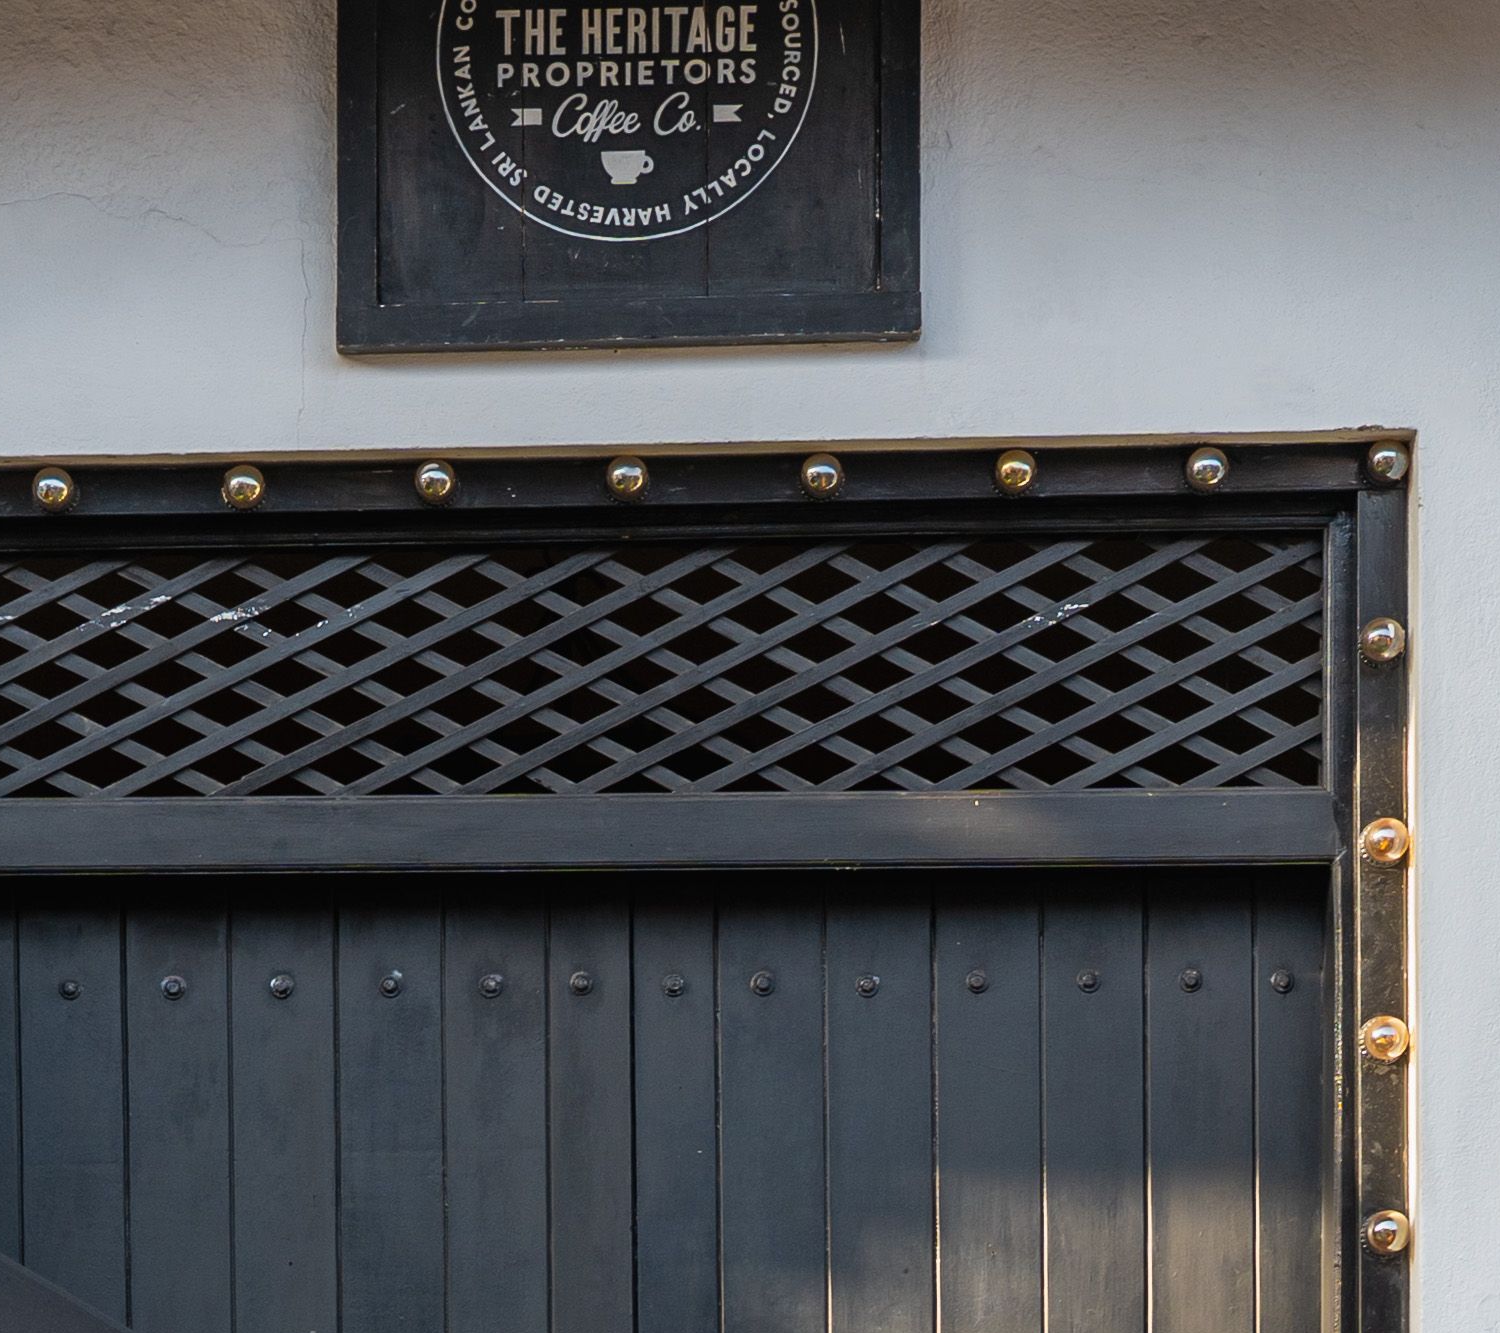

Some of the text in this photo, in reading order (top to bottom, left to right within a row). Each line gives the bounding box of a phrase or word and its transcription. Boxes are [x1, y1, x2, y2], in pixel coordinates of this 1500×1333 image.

[496, 5, 758, 55] THE HERITAGE
[497, 58, 757, 87] PROPRIETORS
[453, 45, 496, 151] LANKAN
[551, 92, 702, 142] Coffee Co.
[491, 151, 528, 187] SRI
[683, 129, 776, 216] LOCALLY
[533, 185, 672, 227] HARVESTED
